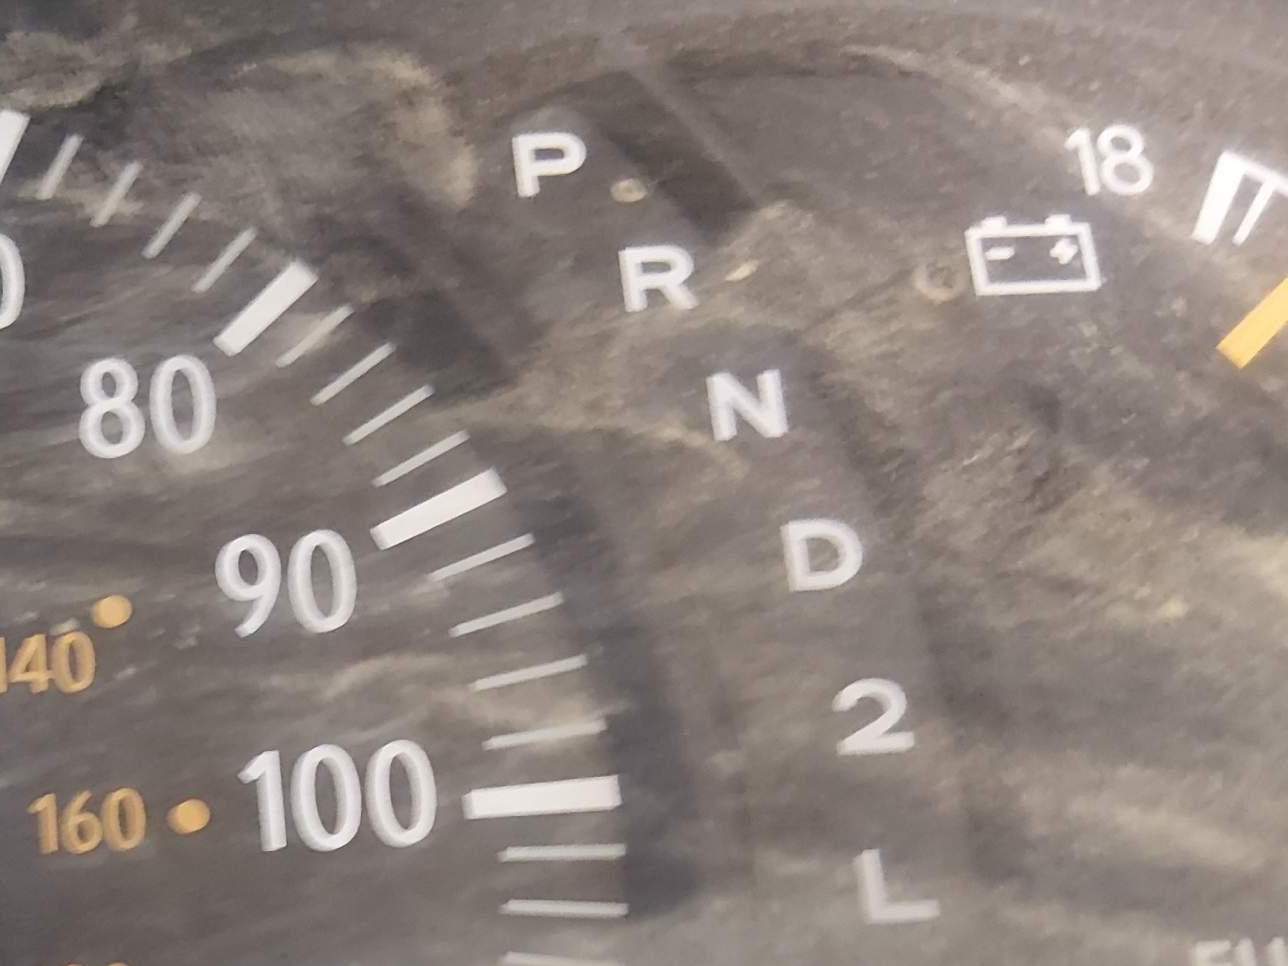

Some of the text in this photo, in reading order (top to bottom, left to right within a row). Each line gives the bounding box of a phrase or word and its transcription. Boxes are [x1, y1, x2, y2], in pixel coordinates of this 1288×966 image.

[512, 132, 587, 197] P
[1064, 125, 1154, 196] 18
[618, 245, 698, 312] R
[77, 354, 218, 460] 80
[707, 369, 789, 441] N
[214, 529, 359, 638] 90
[781, 519, 863, 591] D
[832, 678, 915, 754] 2
[28, 787, 147, 855] 160
[237, 738, 438, 852] 100
[854, 848, 940, 925] L
